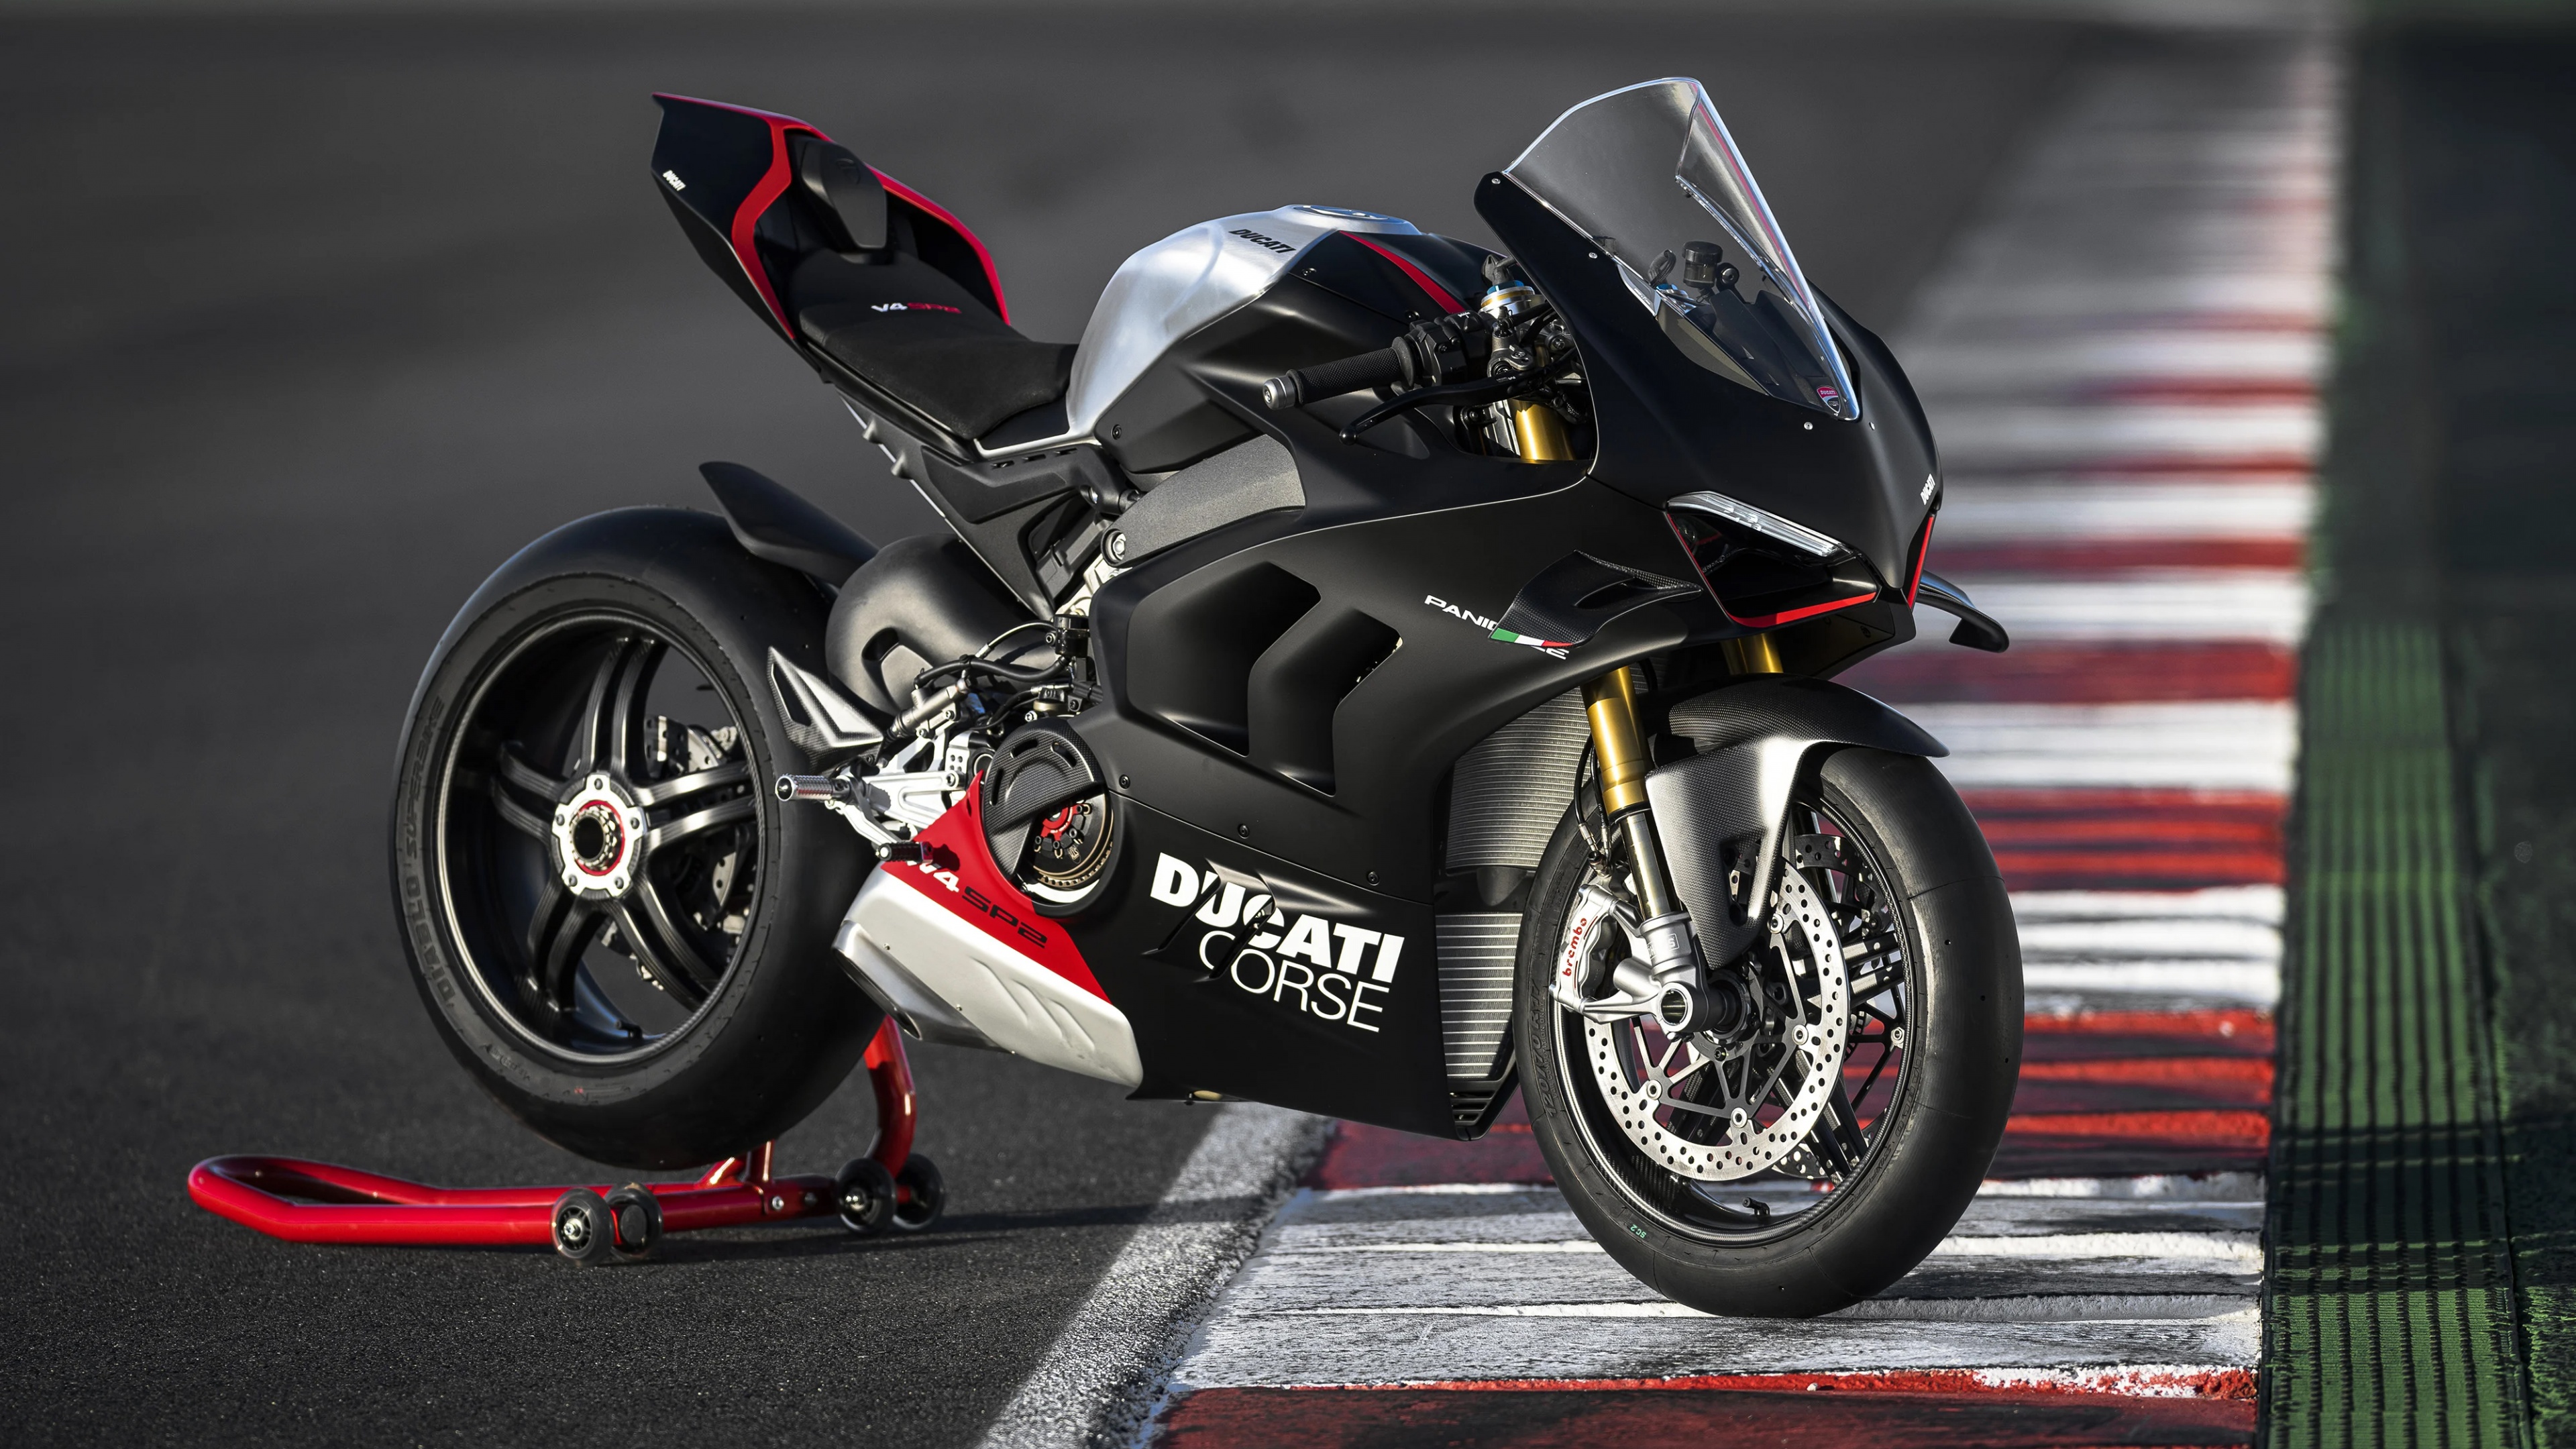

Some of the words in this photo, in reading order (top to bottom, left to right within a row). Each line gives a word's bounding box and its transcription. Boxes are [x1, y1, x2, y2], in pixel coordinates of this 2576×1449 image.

[663, 170, 686, 191] DUCATI
[1228, 229, 1297, 254] DUCATI
[1920, 473, 1935, 506] DUCATI
[406, 875, 455, 1002] DIABLO
[1150, 852, 1405, 983] DUCATI
[1562, 918, 1587, 977] brembo
[1199, 930, 1391, 1032] CORSE
[1532, 1035, 1558, 1118] 120/70
